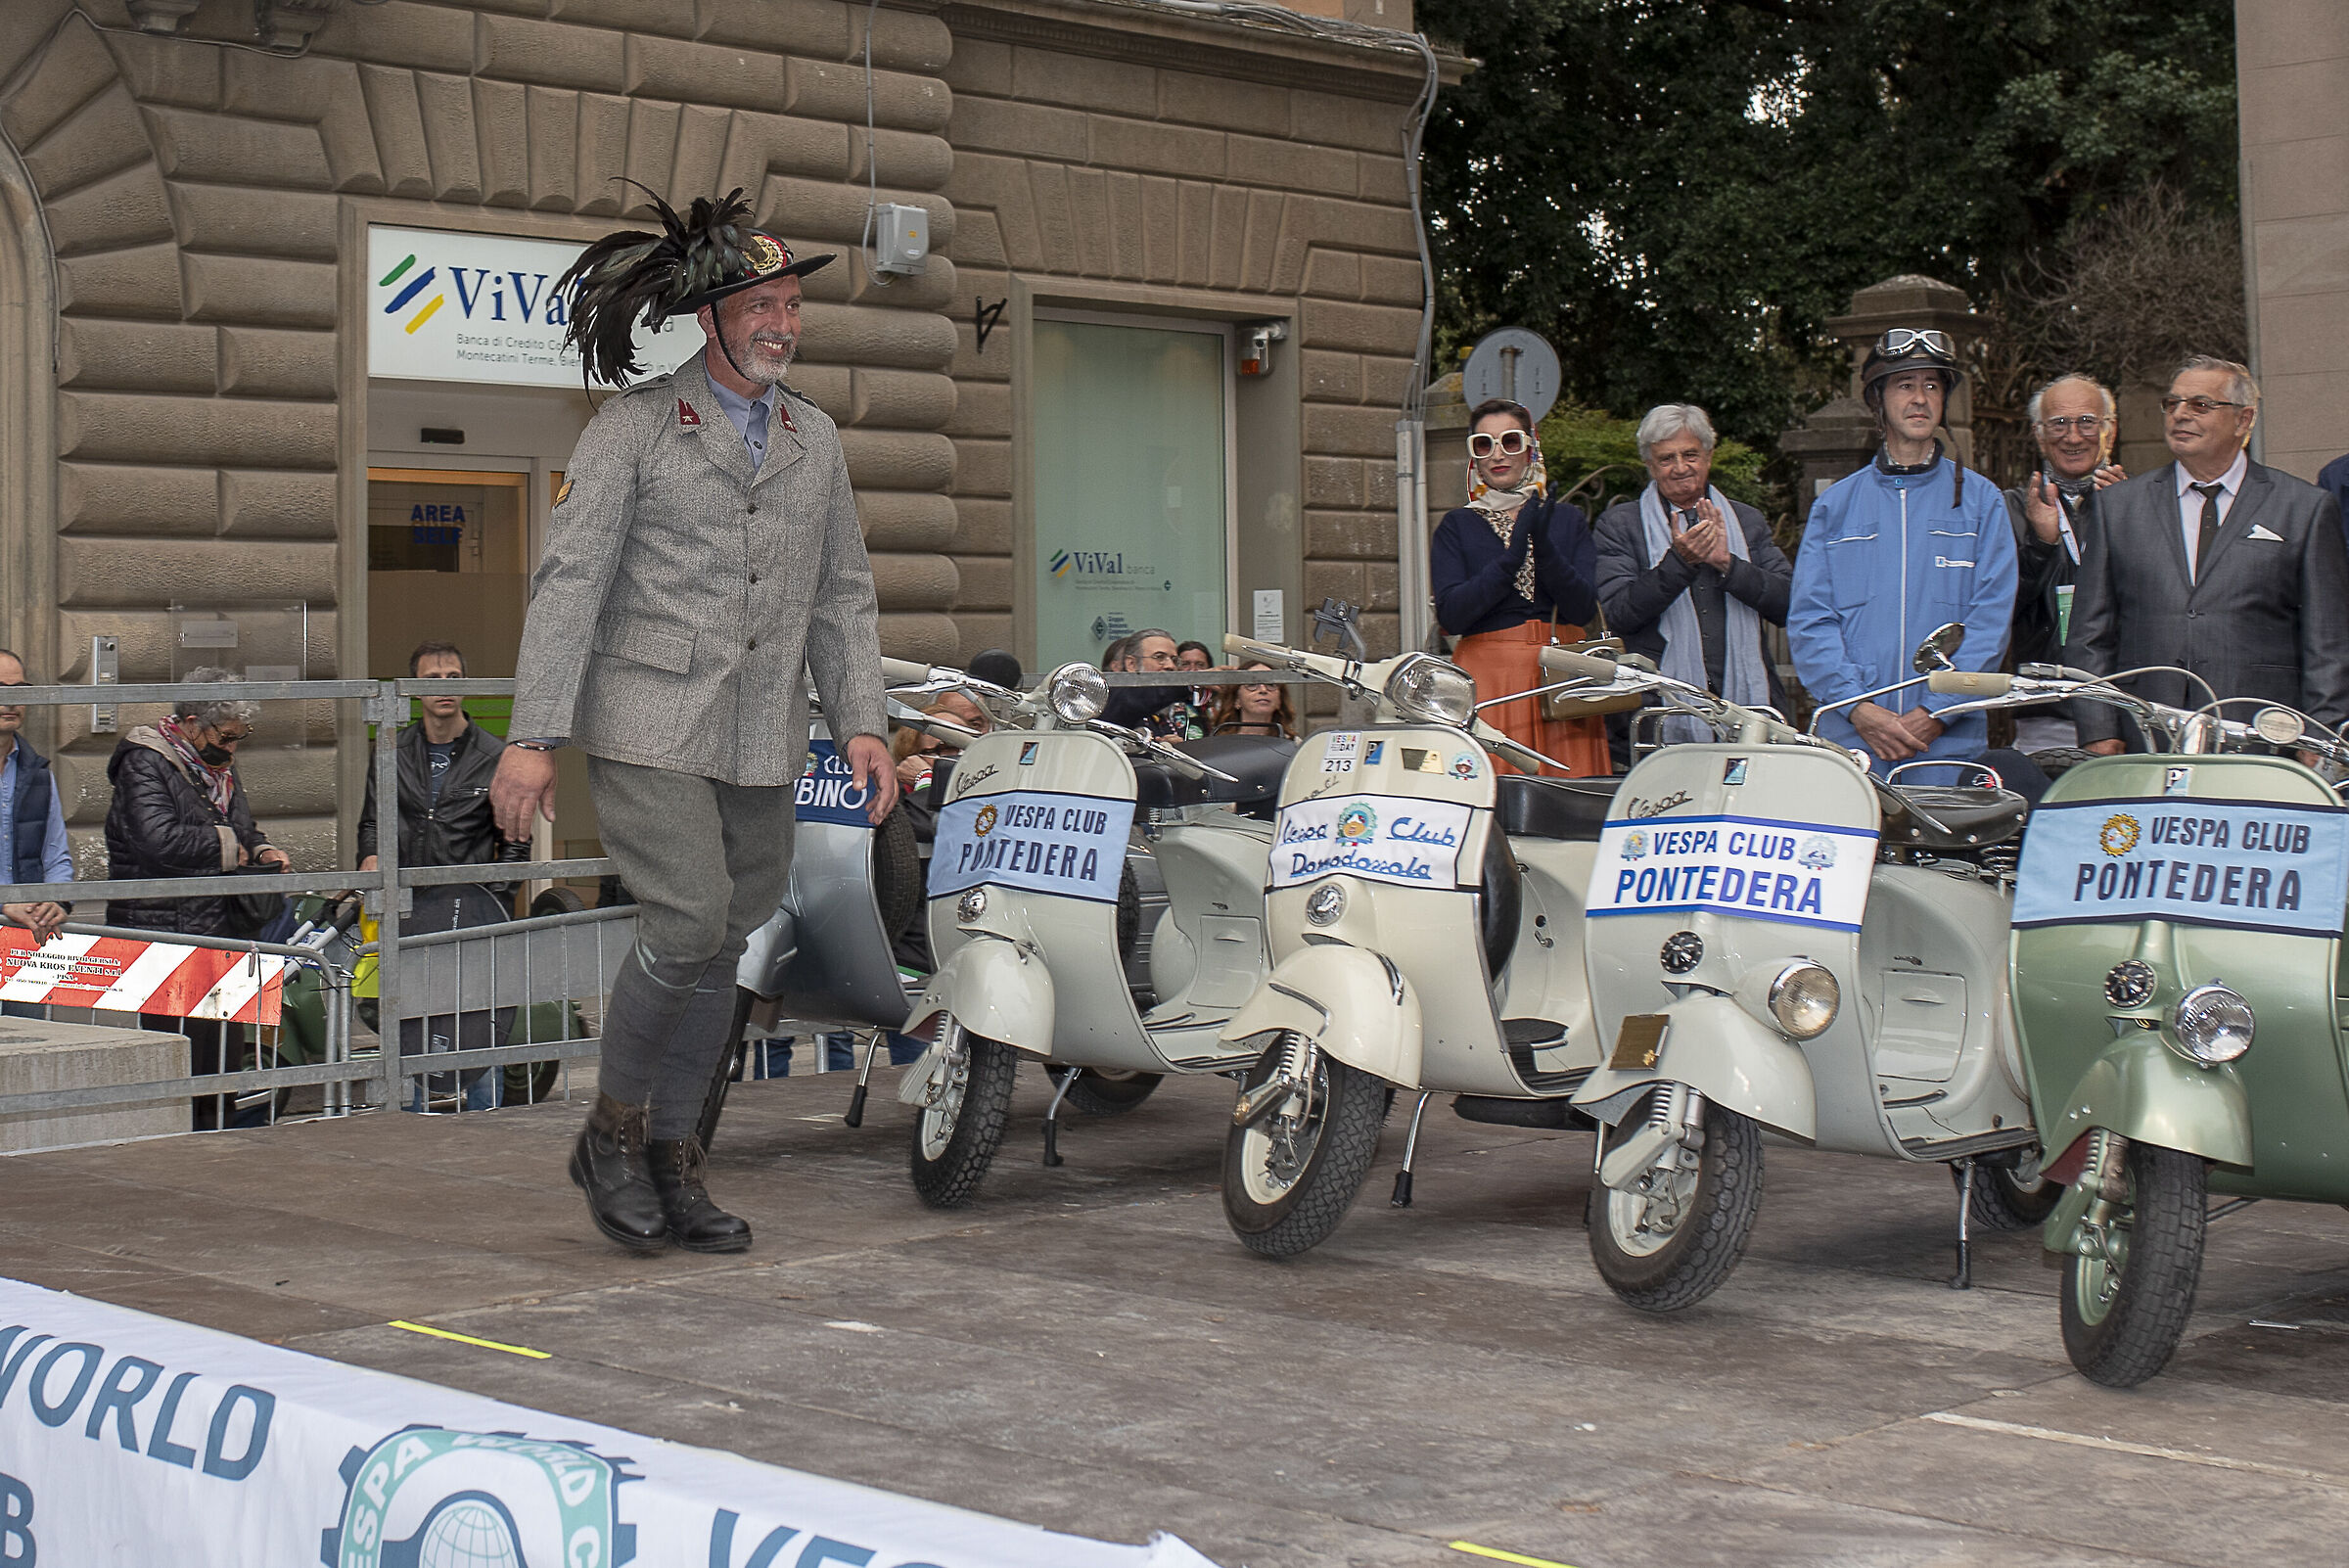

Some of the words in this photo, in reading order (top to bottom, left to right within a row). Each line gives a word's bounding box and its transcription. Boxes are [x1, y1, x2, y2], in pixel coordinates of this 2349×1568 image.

[448, 266, 583, 326] ViVa
[457, 333, 488, 346] Banca
[492, 336, 503, 346] di
[506, 337, 545, 349] Credito
[457, 349, 519, 363] Montecatini
[411, 504, 466, 522] AREA
[414, 527, 463, 544] SELF
[1073, 552, 1123, 574] ViVal
[1339, 743, 1355, 752] DAY
[956, 763, 999, 800] Vespa
[1325, 760, 1352, 772] 213
[794, 778, 868, 810] BINO
[1628, 790, 1693, 818] Vespa
[1004, 805, 1057, 830] VESPA
[1063, 808, 1109, 836] CLUB
[1280, 818, 1329, 846] Vespa
[1386, 816, 1456, 848] Club
[2151, 816, 2232, 849] VESPA
[2242, 820, 2312, 854] CLUB
[957, 839, 1098, 882] PONTEDERA
[1654, 830, 1718, 855] VESPA
[1728, 832, 1797, 861] CLUB
[1290, 849, 1433, 880] Domodossola
[1614, 865, 1822, 914] PONTEDERA
[2074, 859, 2302, 911] PONTEDERA
[7, 958, 37, 968] NUOVA
[39, 961, 66, 971] KROS
[69, 964, 103, 975] EVENTI
[28, 950, 67, 960] NOLEGGIO
[68, 955, 113, 965] RIVOLGERSI
[451, 1442, 597, 1507] WORLD
